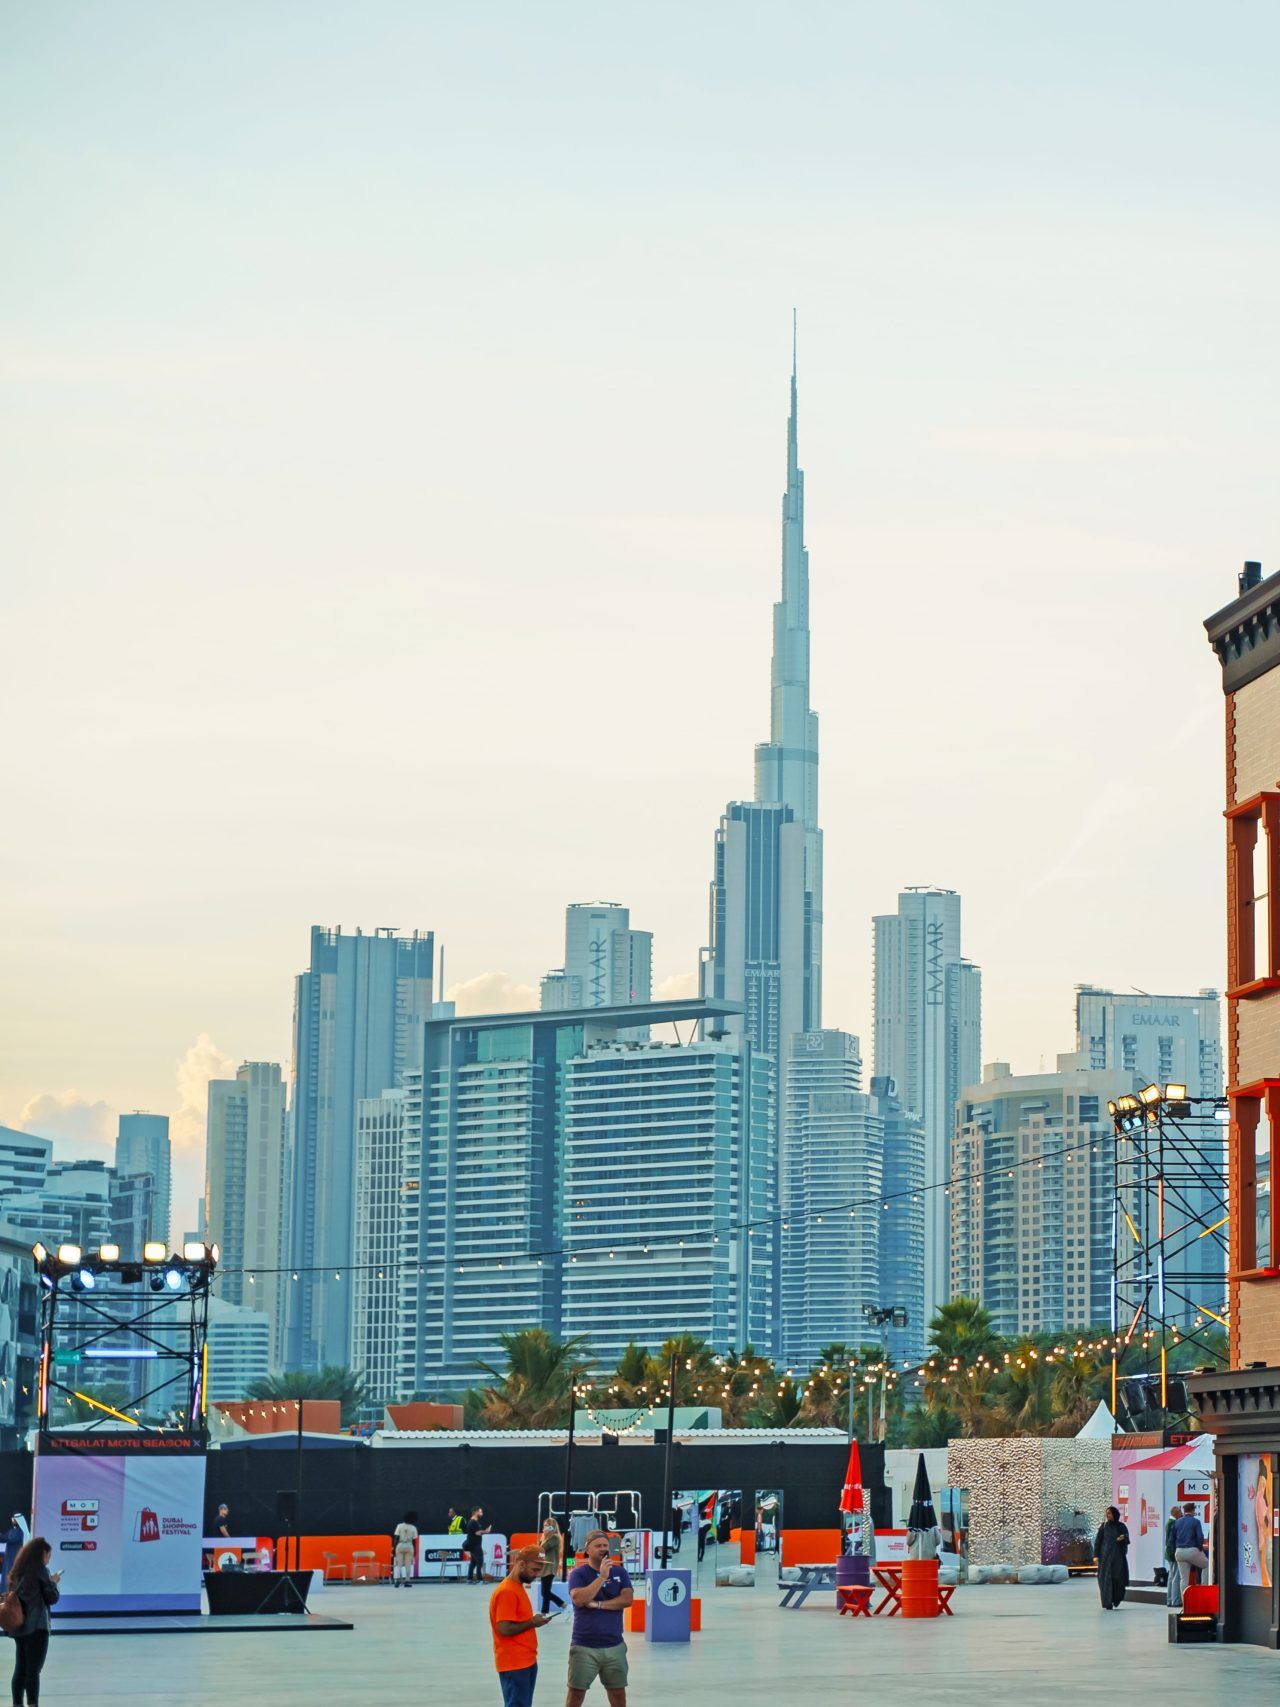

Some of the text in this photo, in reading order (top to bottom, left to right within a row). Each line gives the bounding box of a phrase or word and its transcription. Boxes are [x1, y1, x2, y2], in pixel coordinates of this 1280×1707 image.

[927, 922, 944, 1005] EMAAR
[744, 969, 780, 977] EMAAR
[1132, 1014, 1180, 1026] EMAAR
[143, 1439, 191, 1447] SEASON
